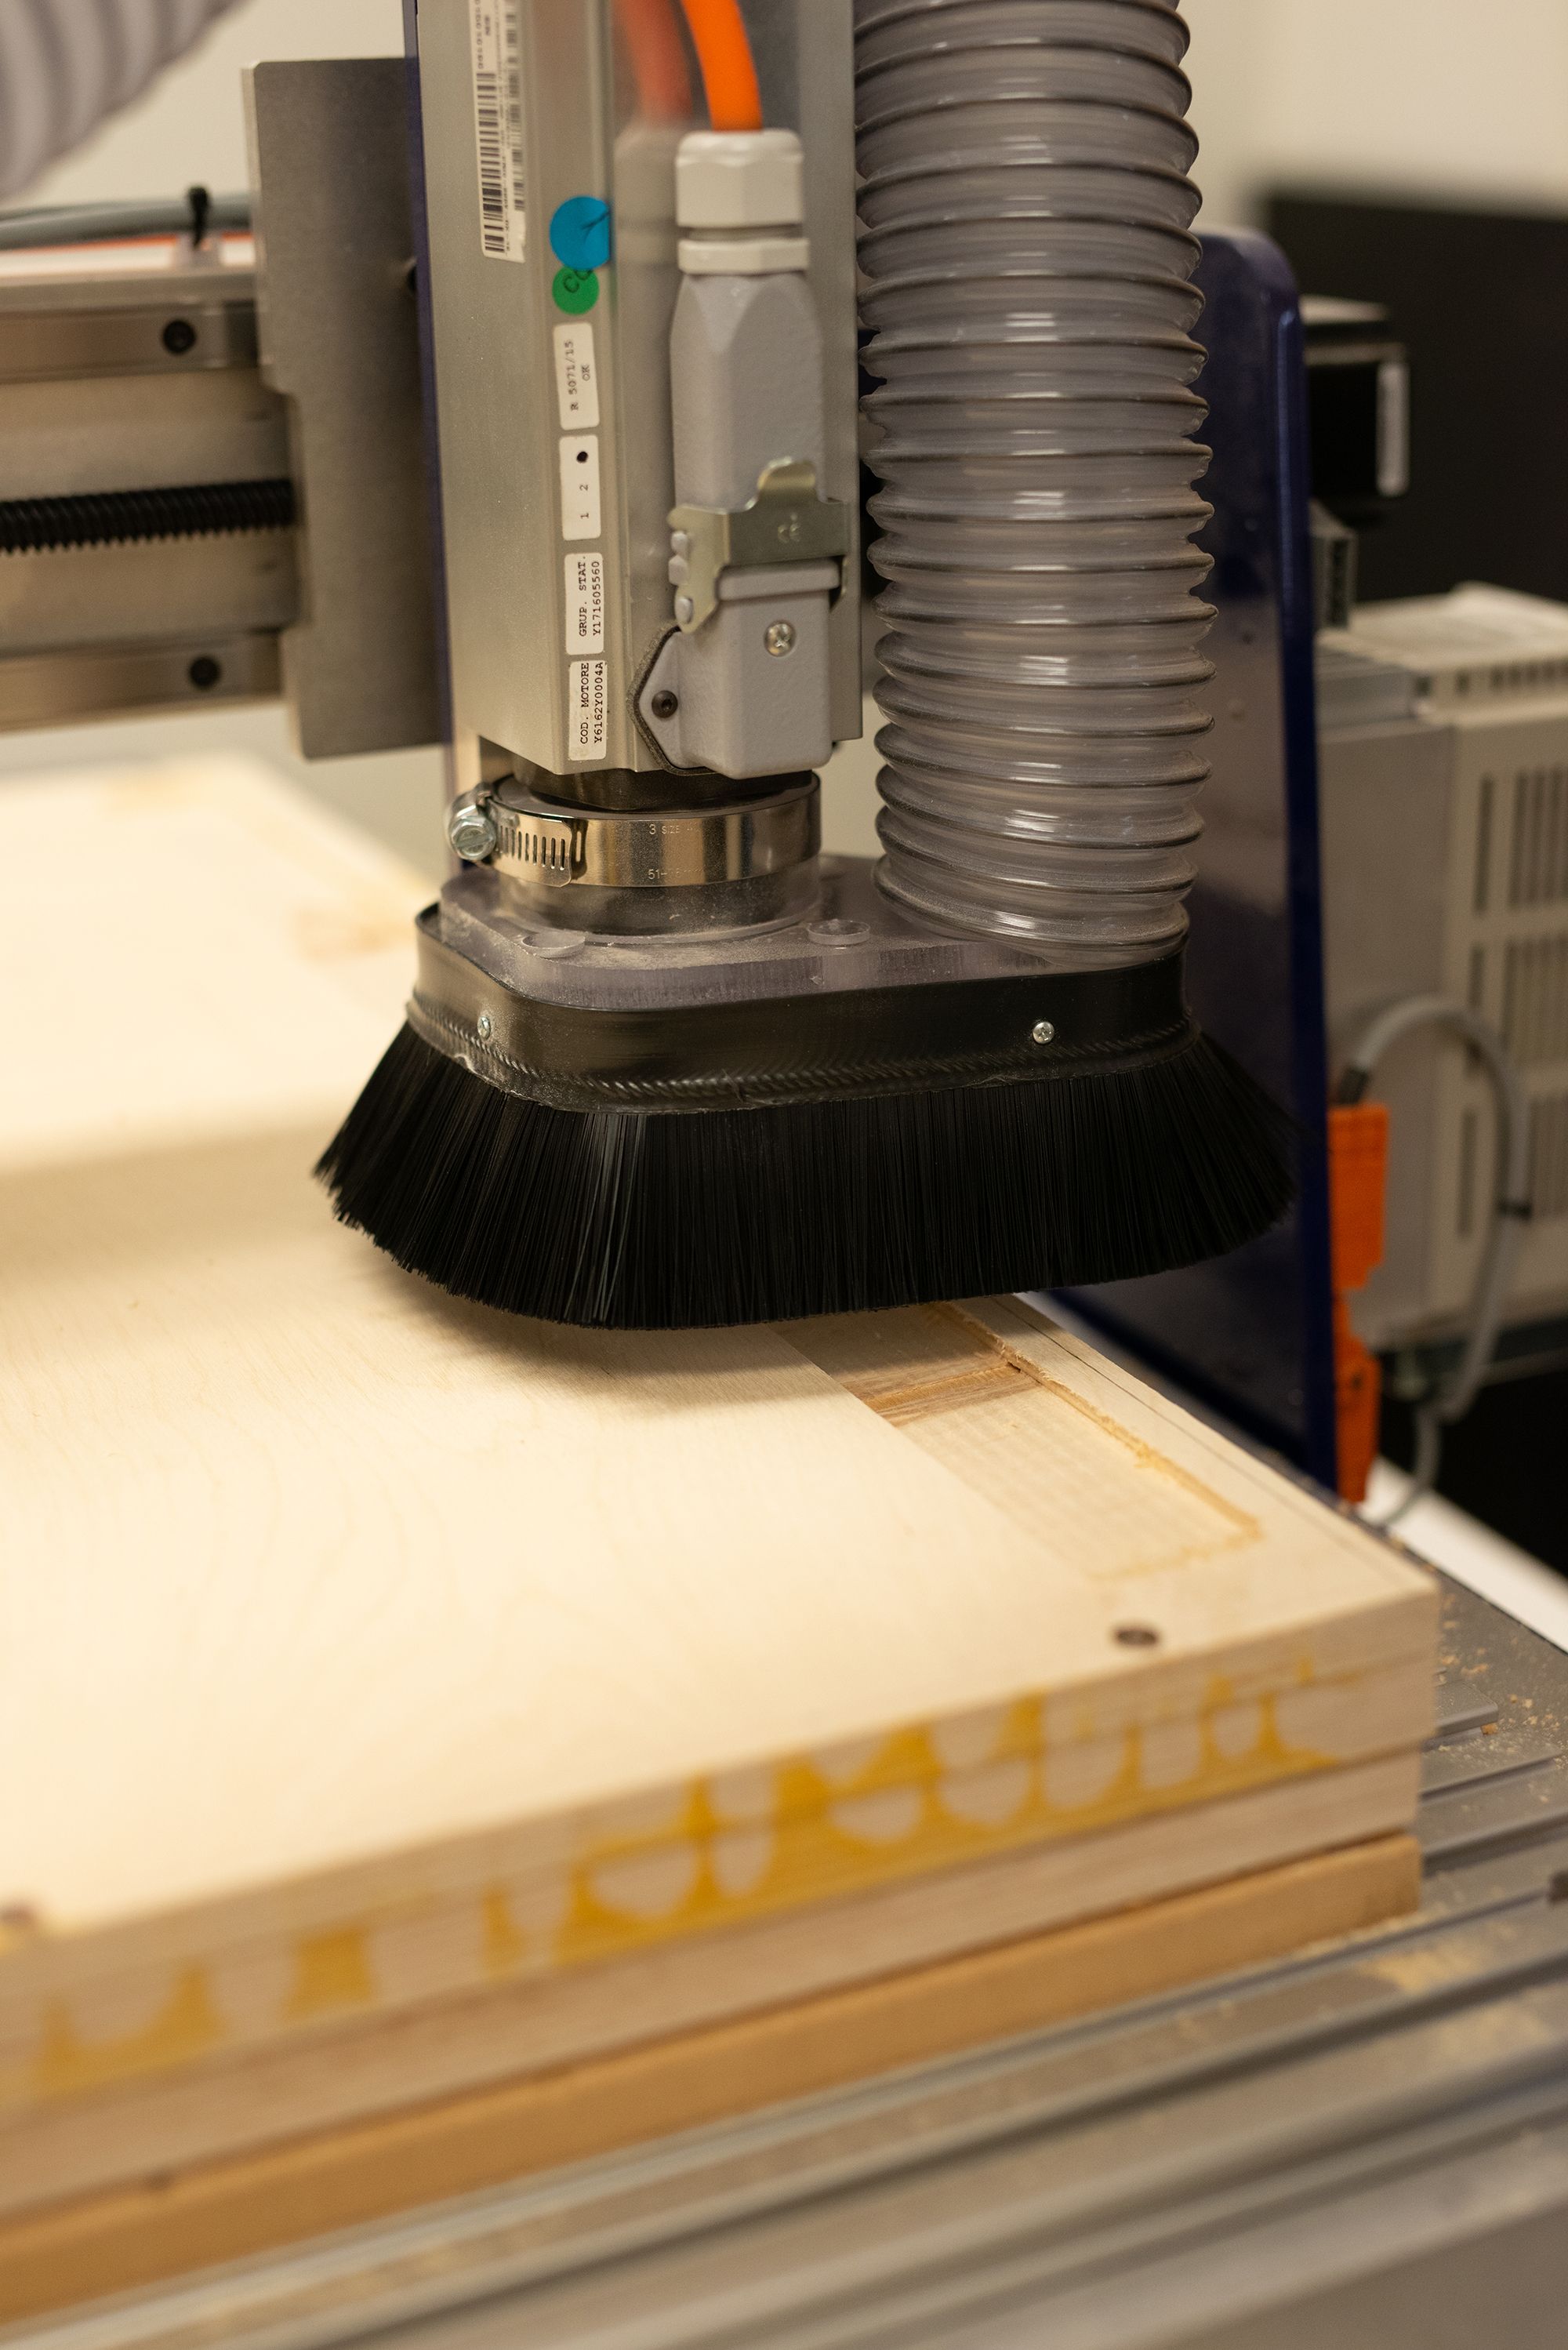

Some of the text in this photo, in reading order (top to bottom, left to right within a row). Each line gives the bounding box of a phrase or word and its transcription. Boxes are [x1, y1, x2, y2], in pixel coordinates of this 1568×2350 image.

[564, 339, 579, 411] R 5071/15
[581, 365, 590, 382] OK
[578, 556, 587, 637] GRUP. STAT.
[591, 561, 601, 636] Y171605560
[580, 717, 589, 744] COD.
[594, 662, 603, 743] Y6162Y0004A
[661, 825, 681, 834] SIZE
